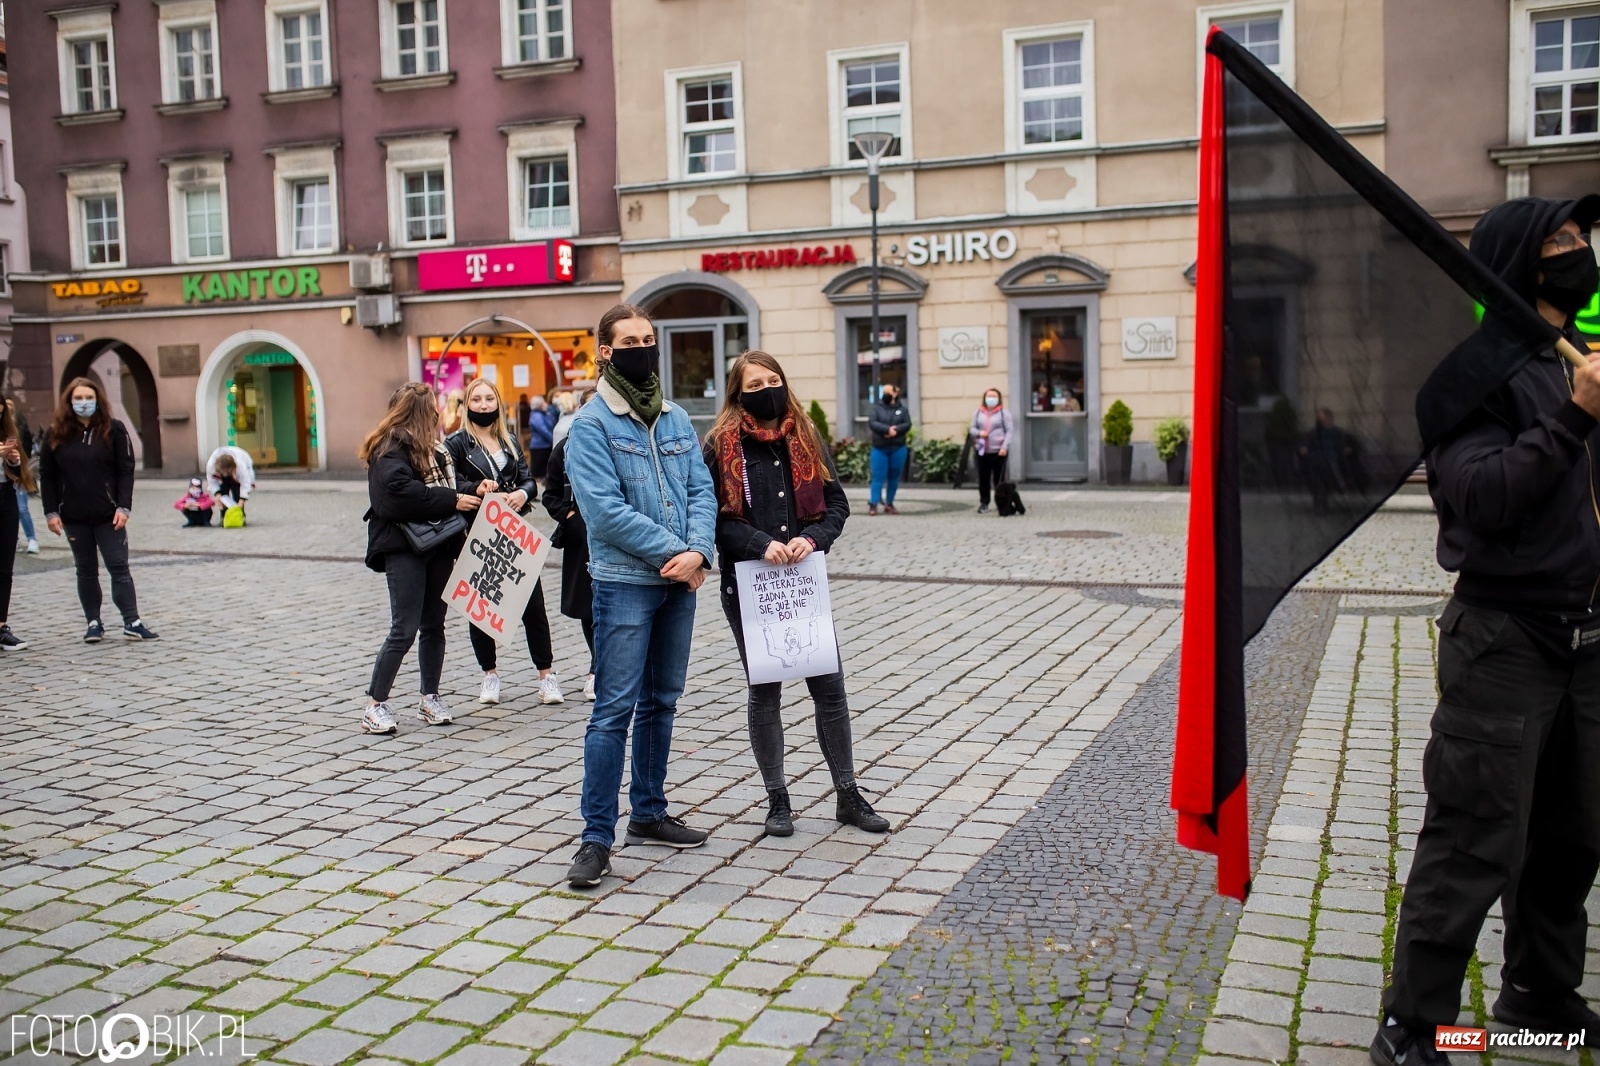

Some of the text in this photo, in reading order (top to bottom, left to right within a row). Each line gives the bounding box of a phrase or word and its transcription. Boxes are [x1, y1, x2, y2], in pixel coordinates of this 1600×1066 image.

[701, 229, 1018, 272] RESTAURACJA SHIRO
[51, 278, 141, 298] TABAC
[182, 266, 322, 303] KANTOR
[245, 352, 294, 365] KANTOR
[485, 500, 541, 556] OCEAN
[489, 528, 523, 563] JEST
[469, 538, 526, 585] CZYSTSZY
[755, 567, 799, 583] MILION NAS
[469, 572, 504, 606] RĘCE
[753, 582, 768, 592] TAK
[770, 578, 796, 590] TERAZ
[790, 590, 795, 598] Z
[798, 587, 814, 597] NAS
[759, 604, 774, 615] SIĘ
[793, 599, 807, 609] NIE
